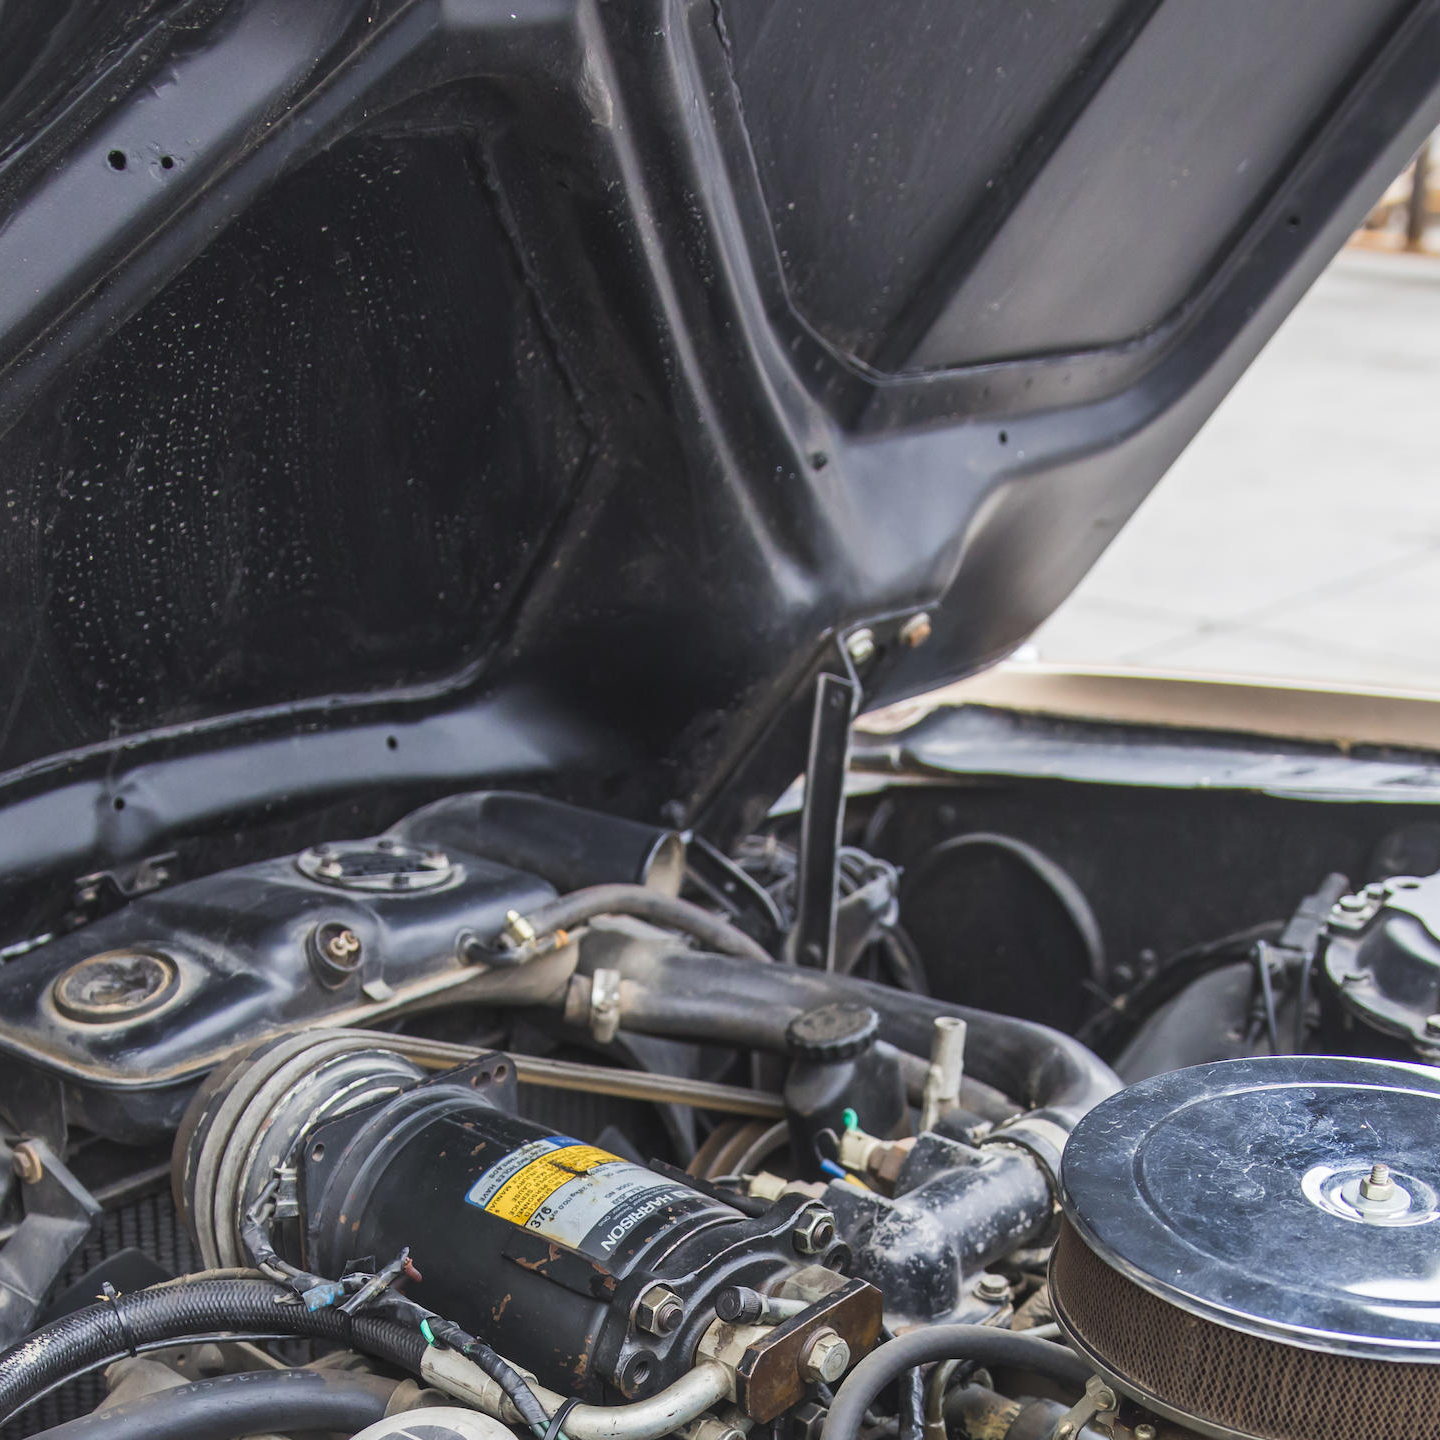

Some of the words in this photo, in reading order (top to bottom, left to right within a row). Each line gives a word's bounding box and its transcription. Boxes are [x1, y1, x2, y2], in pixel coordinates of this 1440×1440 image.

[479, 1184, 495, 1202] HAVE
[487, 1185, 512, 1212] MANUAL
[508, 1189, 533, 1215] SERVICE
[514, 1184, 548, 1218] PERSONNEL
[529, 1205, 553, 1230] 376
[600, 1195, 673, 1251] HARRISON
